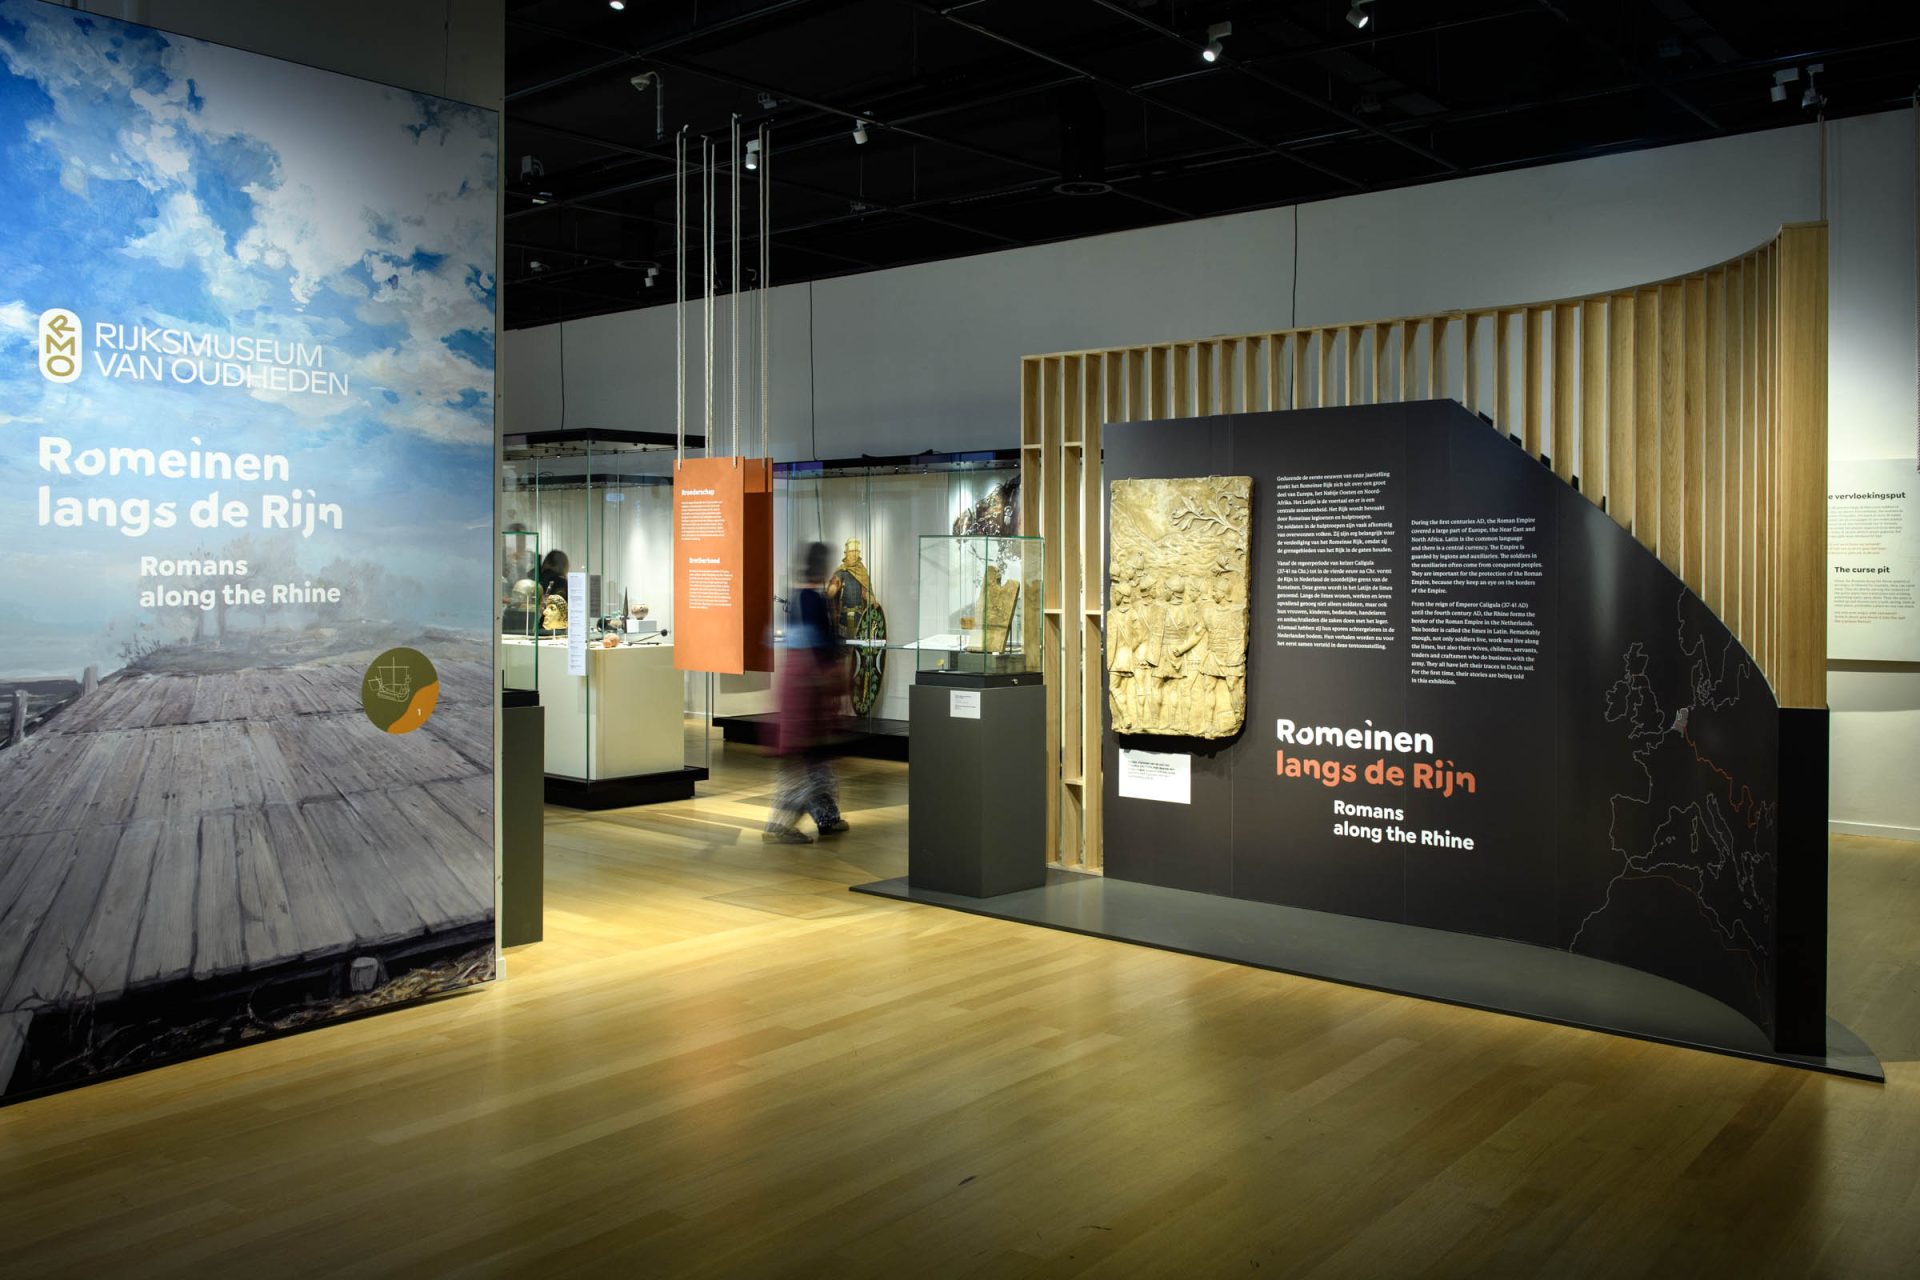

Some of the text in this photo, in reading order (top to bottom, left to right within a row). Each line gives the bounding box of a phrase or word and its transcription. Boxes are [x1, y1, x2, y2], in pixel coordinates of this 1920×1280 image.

[95, 322, 324, 368] RIJKSMUSEUM
[93, 351, 349, 396] VAN OUDHEDEN
[38, 436, 290, 482] Romeinen
[38, 485, 344, 538] langs de Rijn
[1835, 492, 1906, 500] vervloekingsput
[140, 556, 249, 577] Romans
[1878, 566, 1890, 574] pit
[139, 581, 341, 610] along the Rhine
[1276, 718, 1434, 754] Romeinen
[1276, 750, 1476, 798] langs de Rijn
[1334, 800, 1404, 821] Romans
[1334, 820, 1475, 850] along the Rhine
